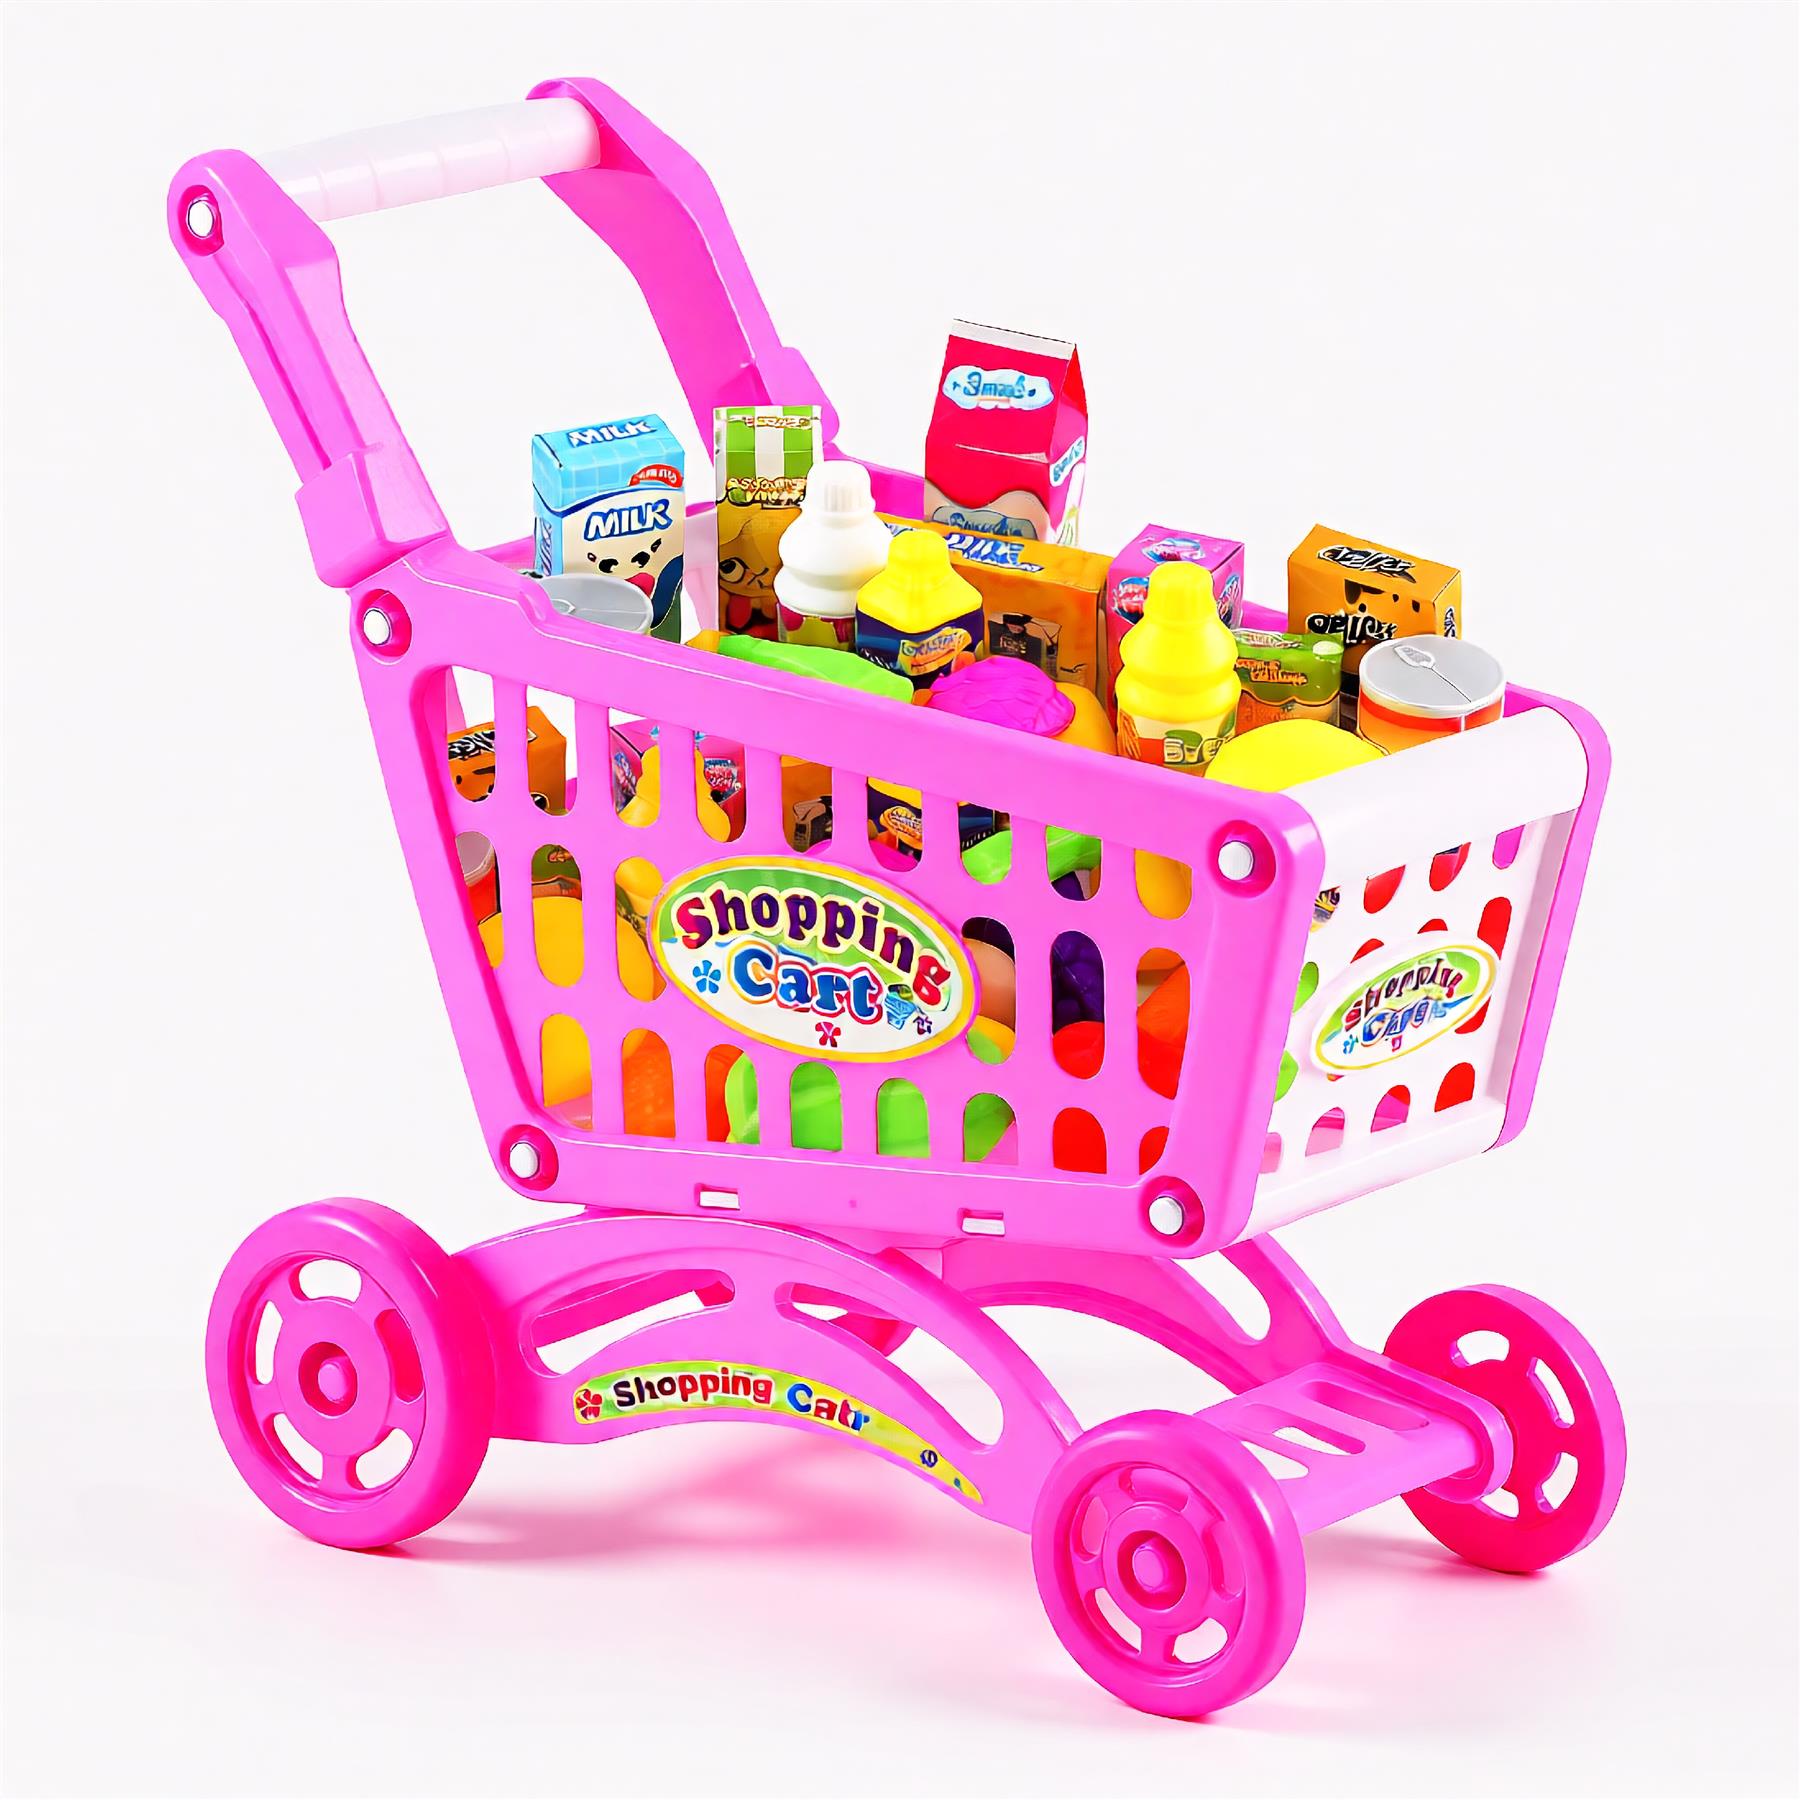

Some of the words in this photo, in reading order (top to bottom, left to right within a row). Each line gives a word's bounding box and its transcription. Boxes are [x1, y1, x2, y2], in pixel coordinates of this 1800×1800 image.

[567, 420, 657, 448] MILK
[583, 498, 673, 541] MILK
[675, 886, 953, 1006] Shopping
[731, 945, 881, 1021] Cart
[612, 1365, 774, 1409] Shopping
